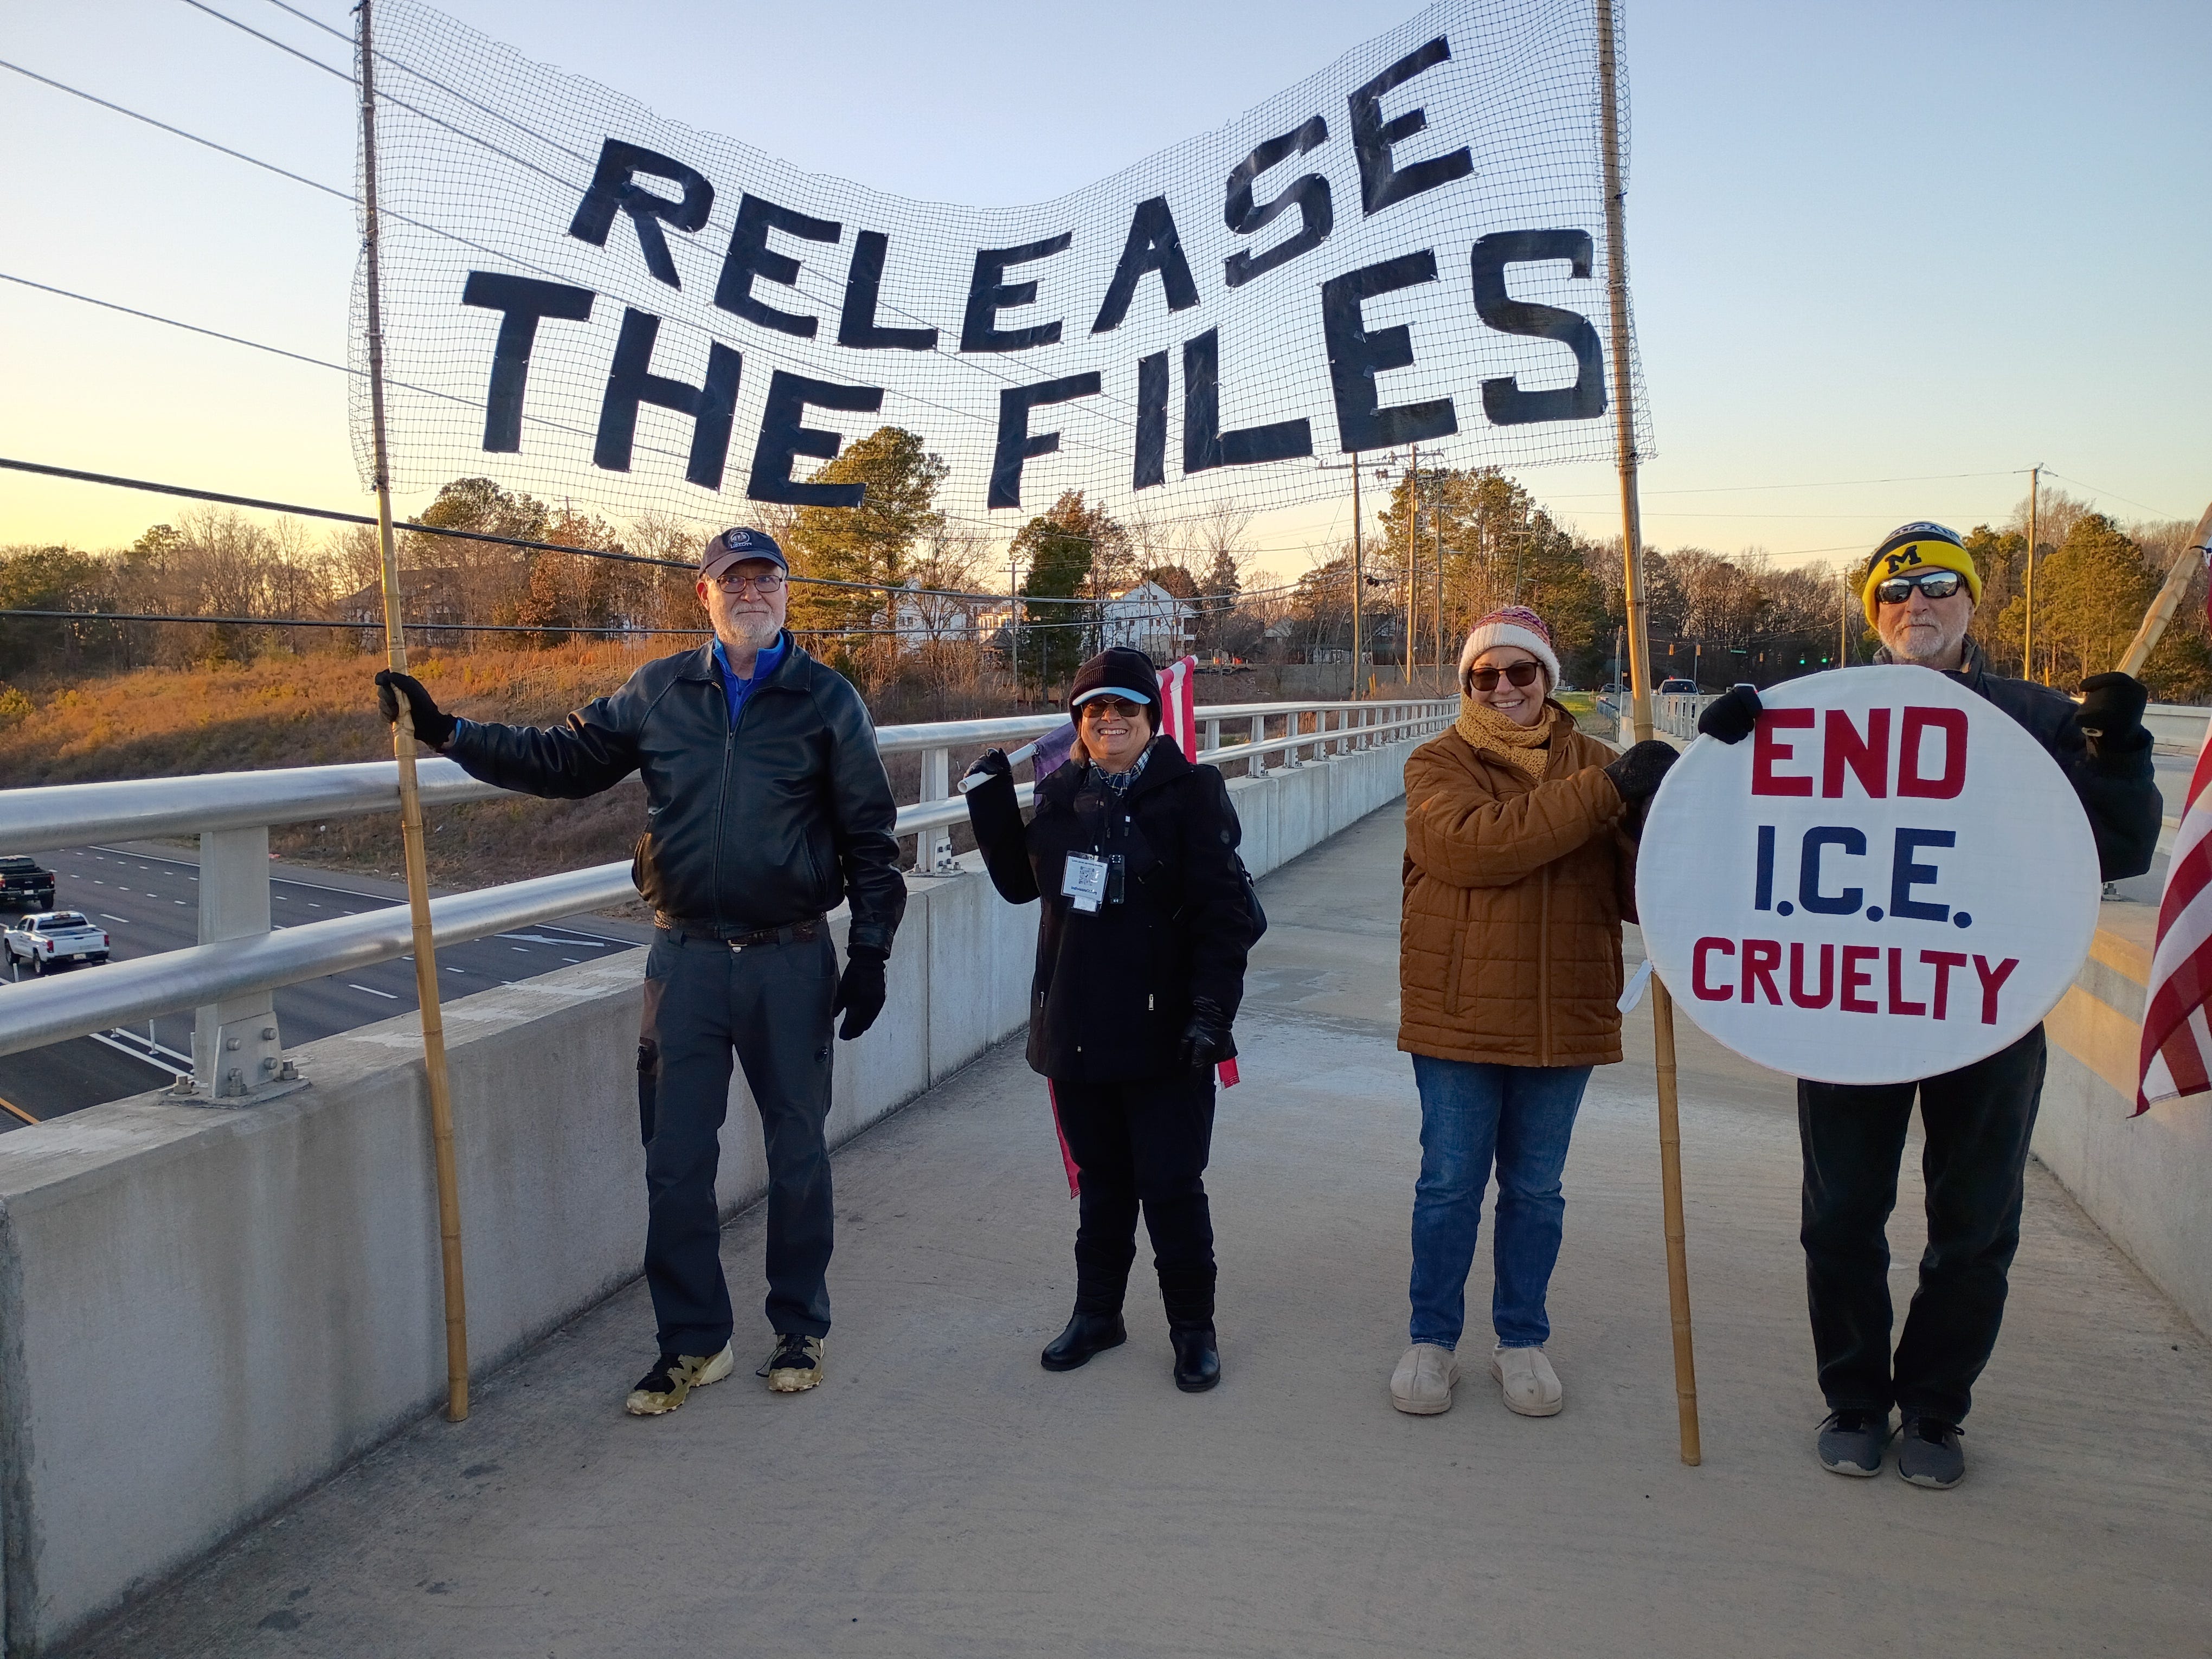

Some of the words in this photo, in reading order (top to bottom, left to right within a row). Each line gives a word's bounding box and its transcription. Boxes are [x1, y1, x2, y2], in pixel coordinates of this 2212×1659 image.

[569, 37, 1474, 352] RELEASE
[462, 270, 885, 509] THE
[987, 228, 1607, 510] FILES
[1885, 544, 1922, 574] M
[1751, 706, 1969, 800] END
[1754, 825, 1972, 929] I.C.E.
[1692, 936, 2020, 1025] CRUELTY
